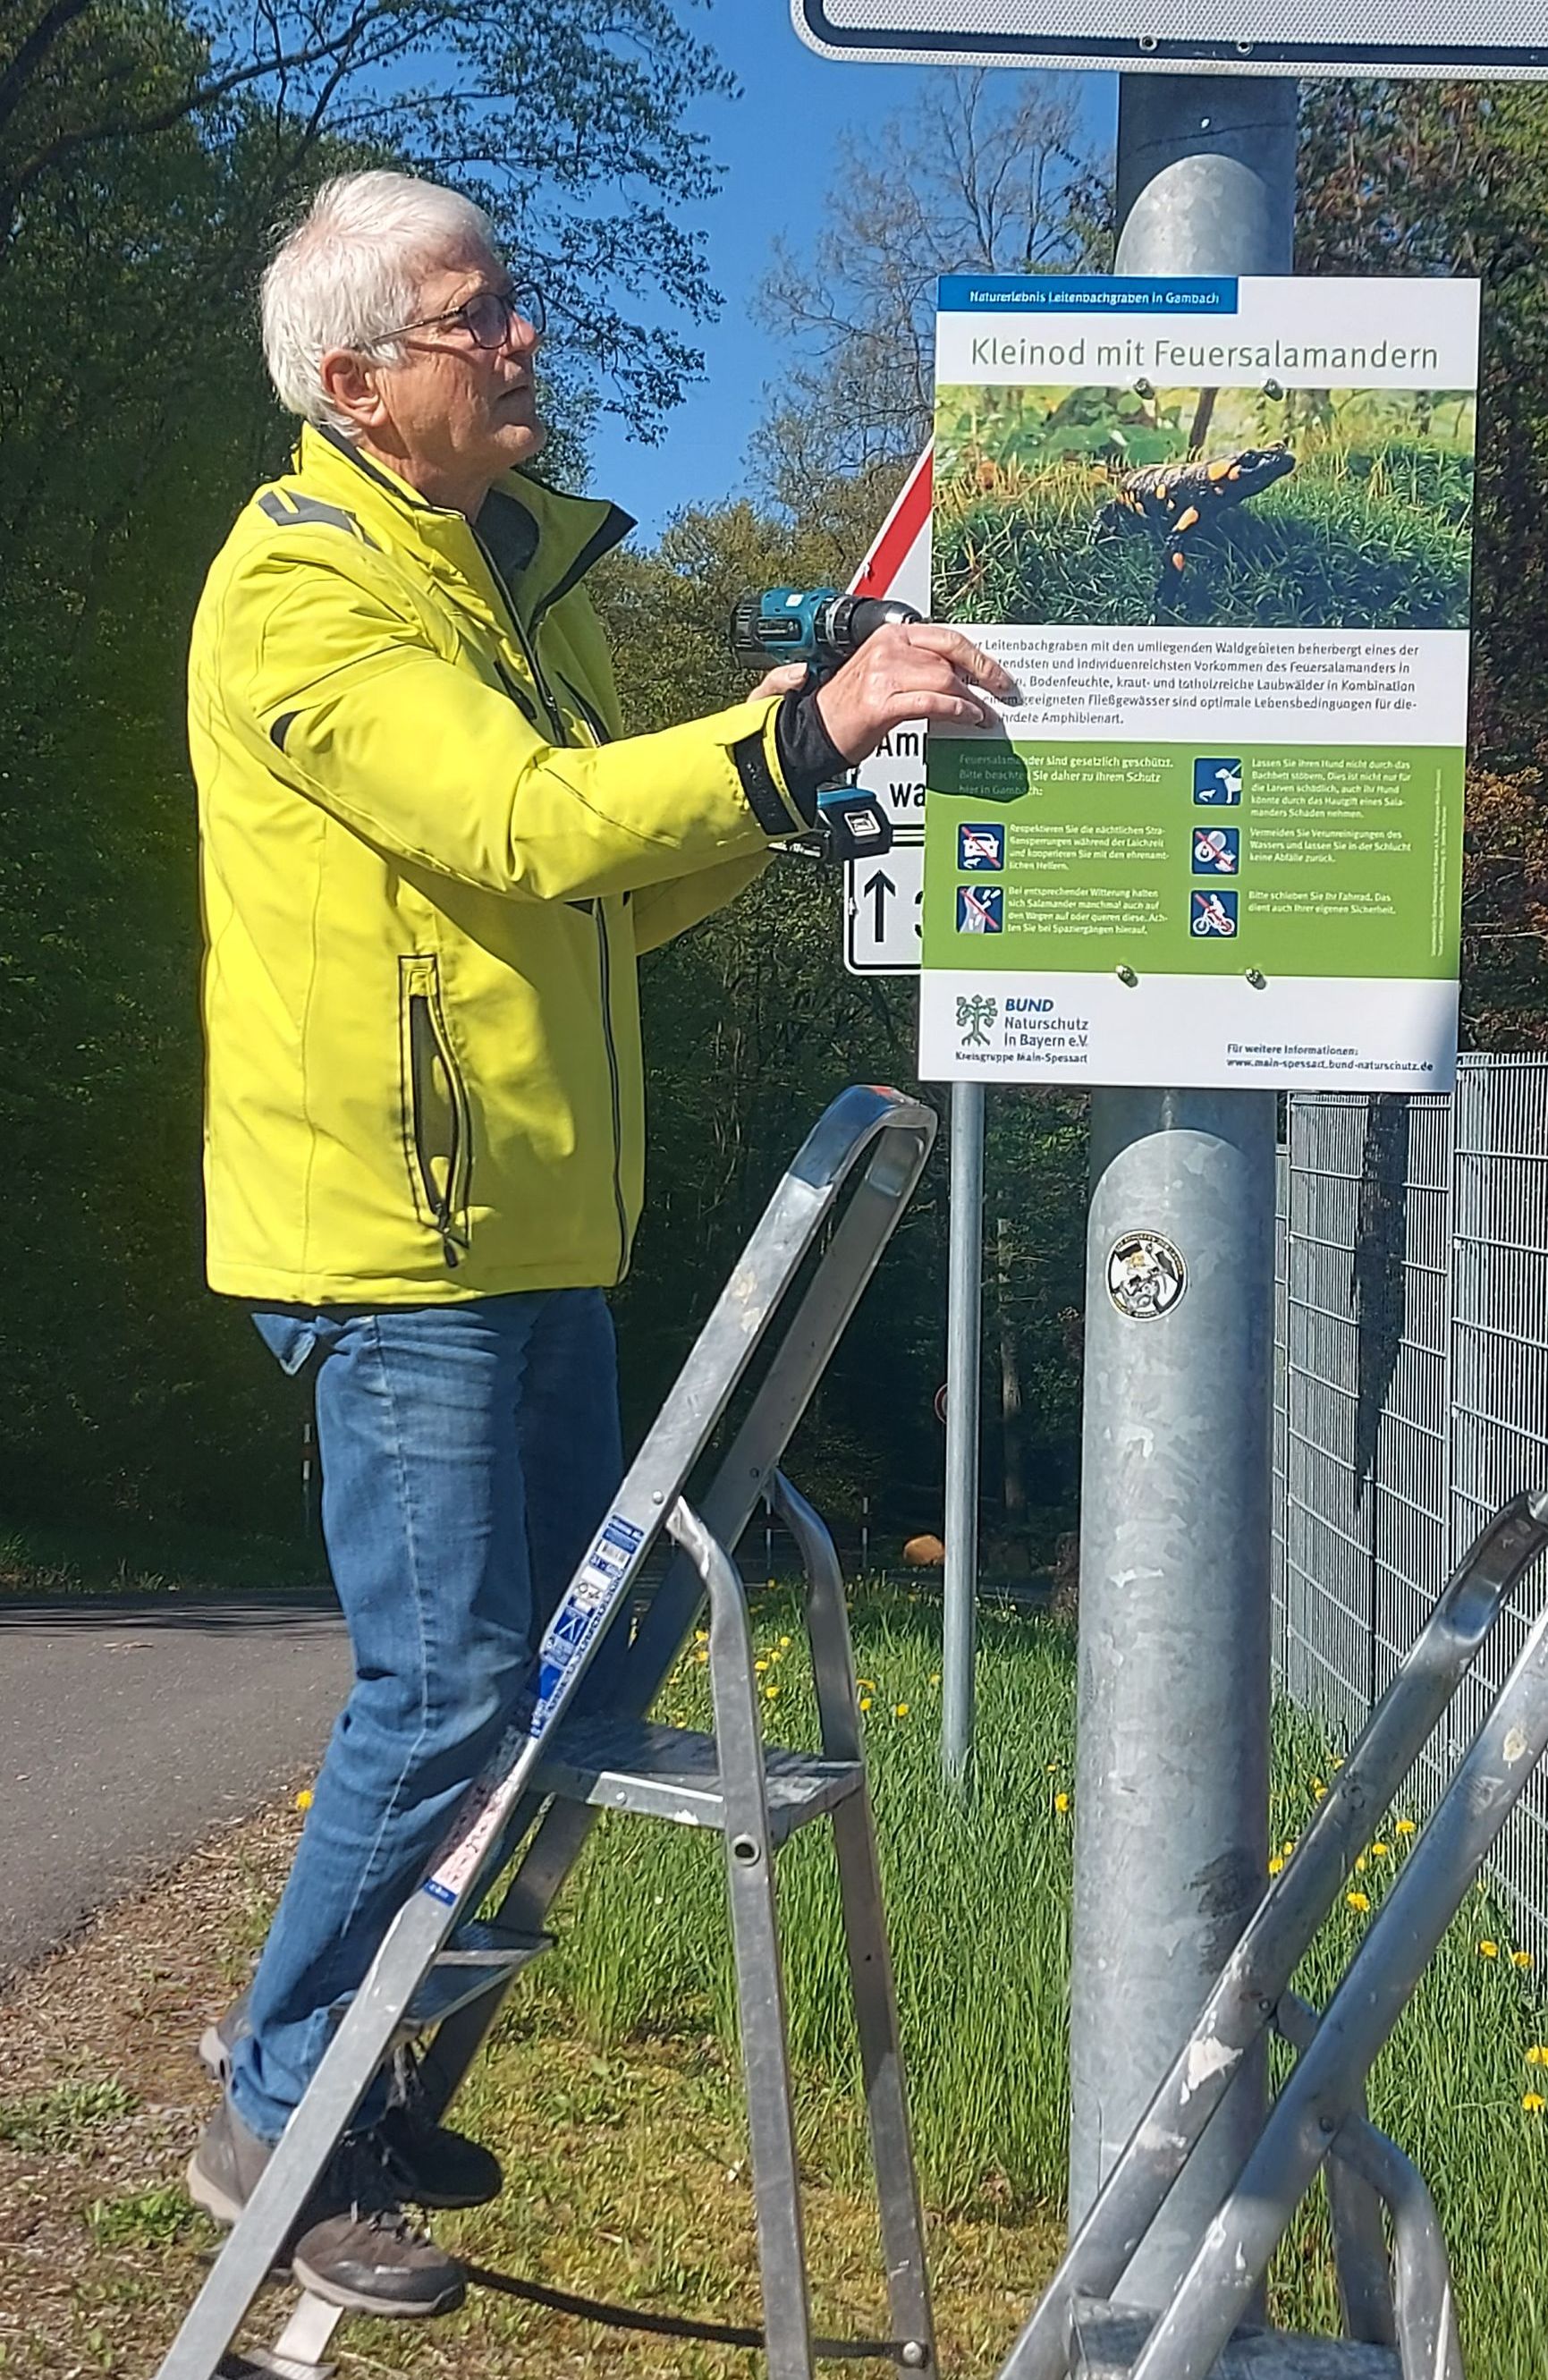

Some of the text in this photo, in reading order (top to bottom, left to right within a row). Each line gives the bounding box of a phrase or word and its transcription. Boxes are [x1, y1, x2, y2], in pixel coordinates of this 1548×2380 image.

[970, 292, 1046, 302] Naturerlebnis
[1048, 292, 1149, 306] Leitenbachgraben
[1165, 292, 1219, 304] Gambach
[971, 337, 1438, 369] Kleinod mit Feuersalamandern
[985, 639, 1087, 655] Leitenbachgraben
[1090, 641, 1110, 652] mit
[1112, 641, 1134, 652] den
[1138, 641, 1212, 656] umliegenden
[1215, 642, 1295, 657] Waldgebieten
[1298, 644, 1361, 657] beherbergt
[1365, 645, 1396, 656] eines
[1399, 645, 1419, 656] der
[1052, 658, 1074, 670] und
[1194, 660, 1263, 672] Vorkommen
[1265, 661, 1288, 672] des
[1290, 661, 1396, 673] Feuersalamanders
[1029, 676, 1113, 690] Bodenfeuchte,
[1116, 677, 1150, 688] kraut-
[1154, 677, 1175, 689] und
[1257, 679, 1324, 690] Laubwälder
[1341, 680, 1415, 691] Kombination
[1088, 695, 1170, 709] Fließgewässer
[1172, 696, 1197, 707] sind
[1200, 696, 1251, 710] optimale
[1255, 697, 1371, 712] Lebensbedingungen
[1375, 699, 1391, 709] für
[1393, 699, 1417, 709] die-
[1041, 712, 1124, 726] Amphibienart.
[1045, 756, 1068, 767] sind
[1070, 756, 1120, 769] gesetzlich
[1033, 771, 1049, 781] Sie
[1051, 771, 1080, 782] daher
[1081, 774, 1094, 782] zu
[1126, 772, 1161, 783] Schutz
[1005, 998, 1053, 1012] BUND
[1004, 1017, 1088, 1030] Naturschutz
[1019, 1034, 1064, 1049] Bayern
[1227, 1044, 1243, 1054] Für
[1245, 1045, 1282, 1054] weitere
[955, 1052, 1087, 1063] Kreisgruppe Main-Spessart
